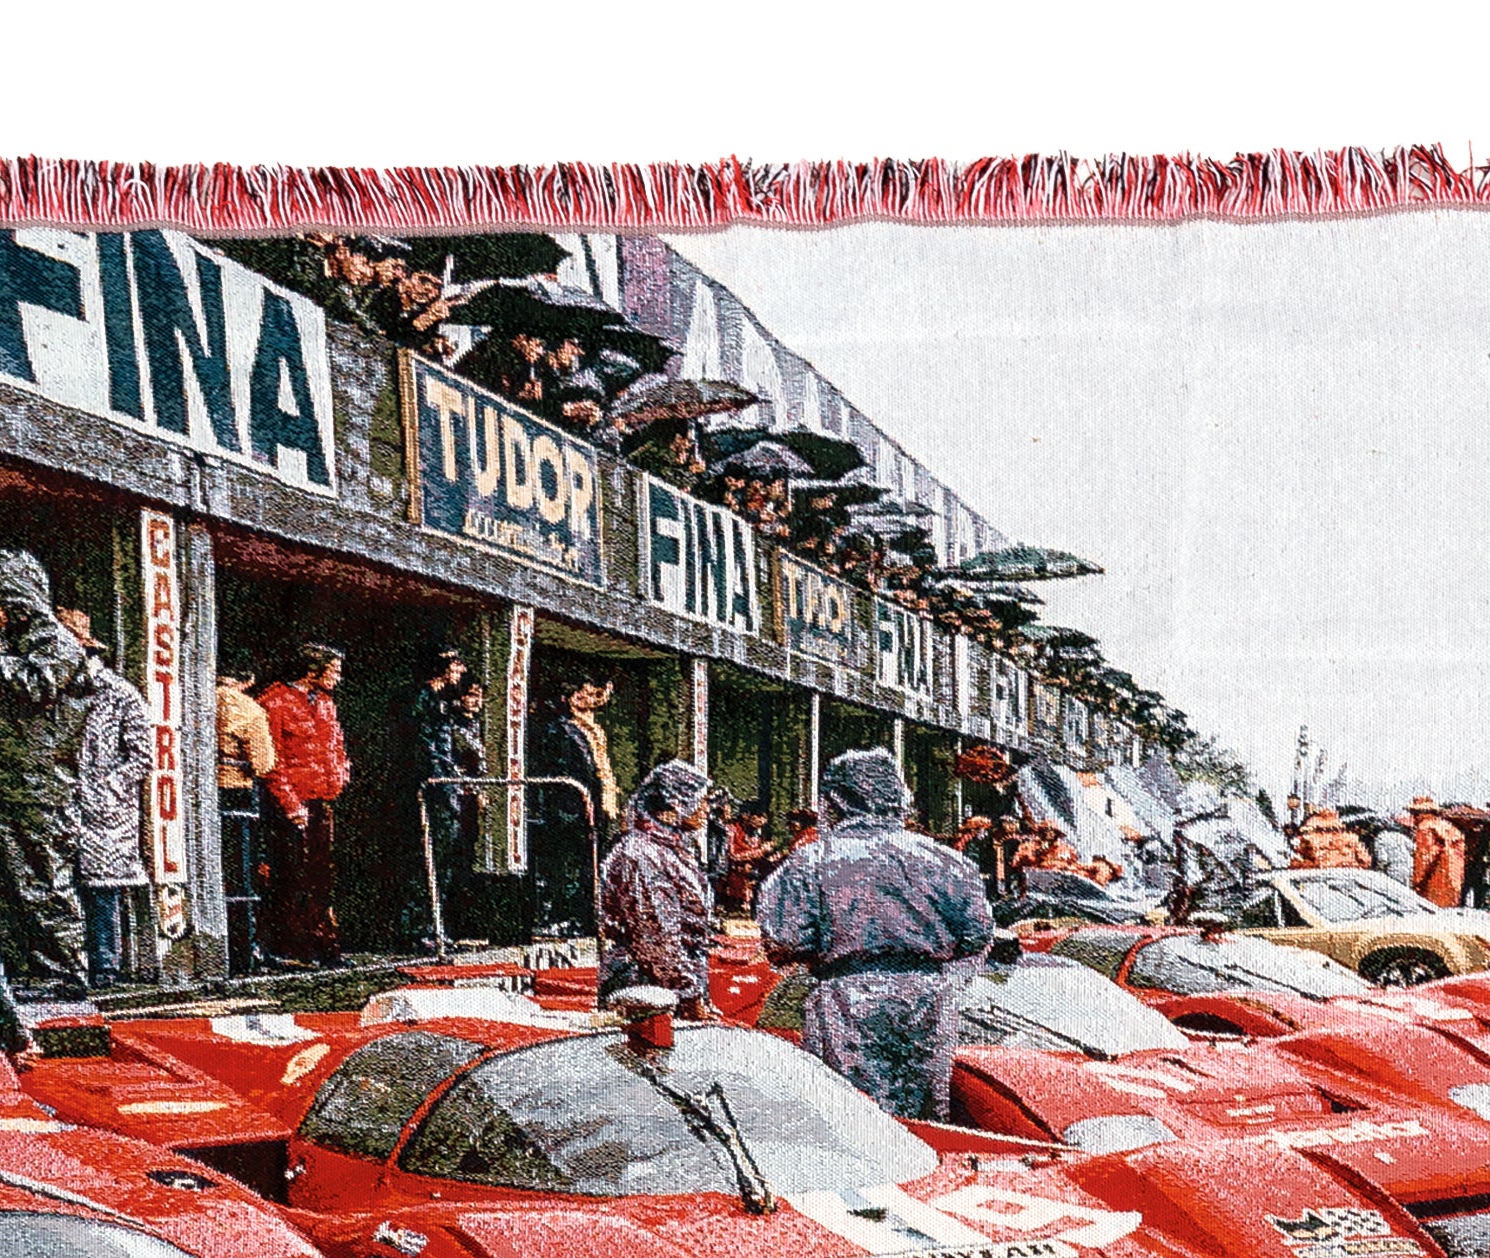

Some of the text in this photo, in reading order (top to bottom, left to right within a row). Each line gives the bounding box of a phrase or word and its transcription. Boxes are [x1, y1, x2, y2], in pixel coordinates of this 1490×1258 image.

[425, 374, 592, 541] TUDOR
[649, 482, 754, 632] FINA
[146, 518, 179, 874] CASTROL
